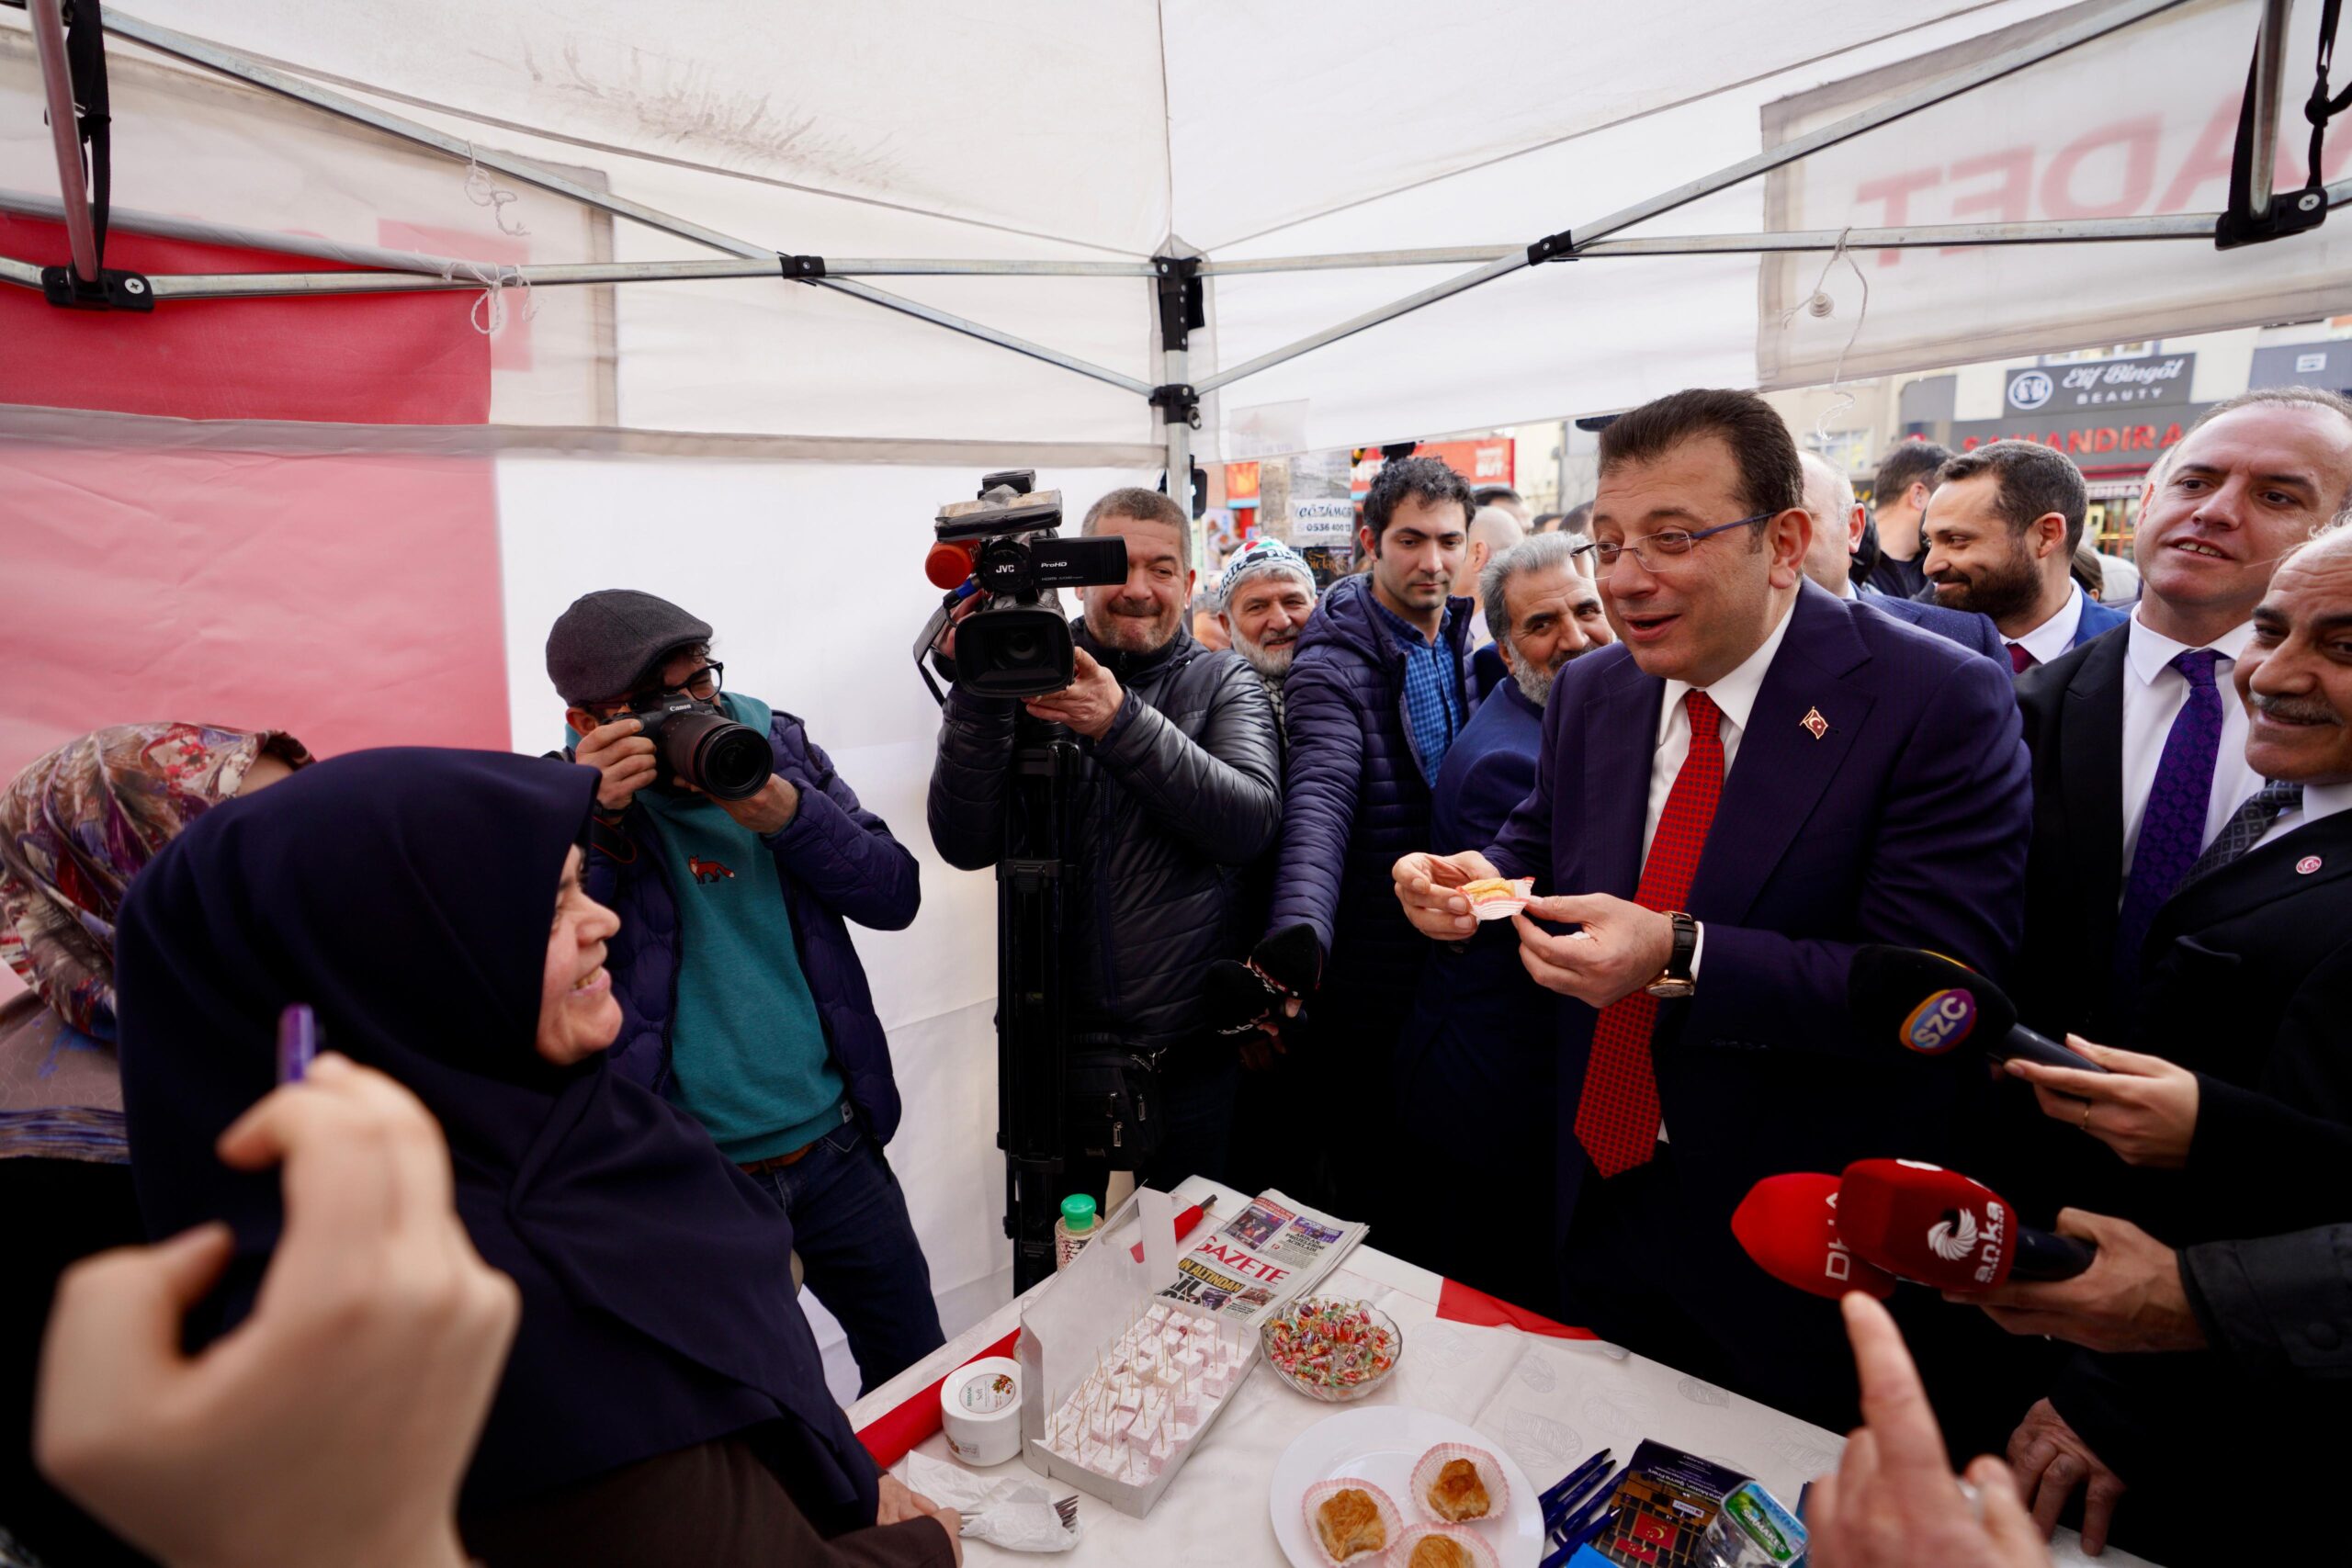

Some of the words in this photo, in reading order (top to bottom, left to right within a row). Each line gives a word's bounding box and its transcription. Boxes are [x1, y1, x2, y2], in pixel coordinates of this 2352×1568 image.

[2103, 358, 2185, 385] Bingöl
[2076, 387, 2163, 405] BEAUTY
[995, 564, 1015, 573] JVC
[669, 704, 692, 712] Canon
[1914, 997, 1968, 1048] SZC
[1974, 1201, 2004, 1283] anka
[1194, 1235, 1291, 1285] GAZETE
